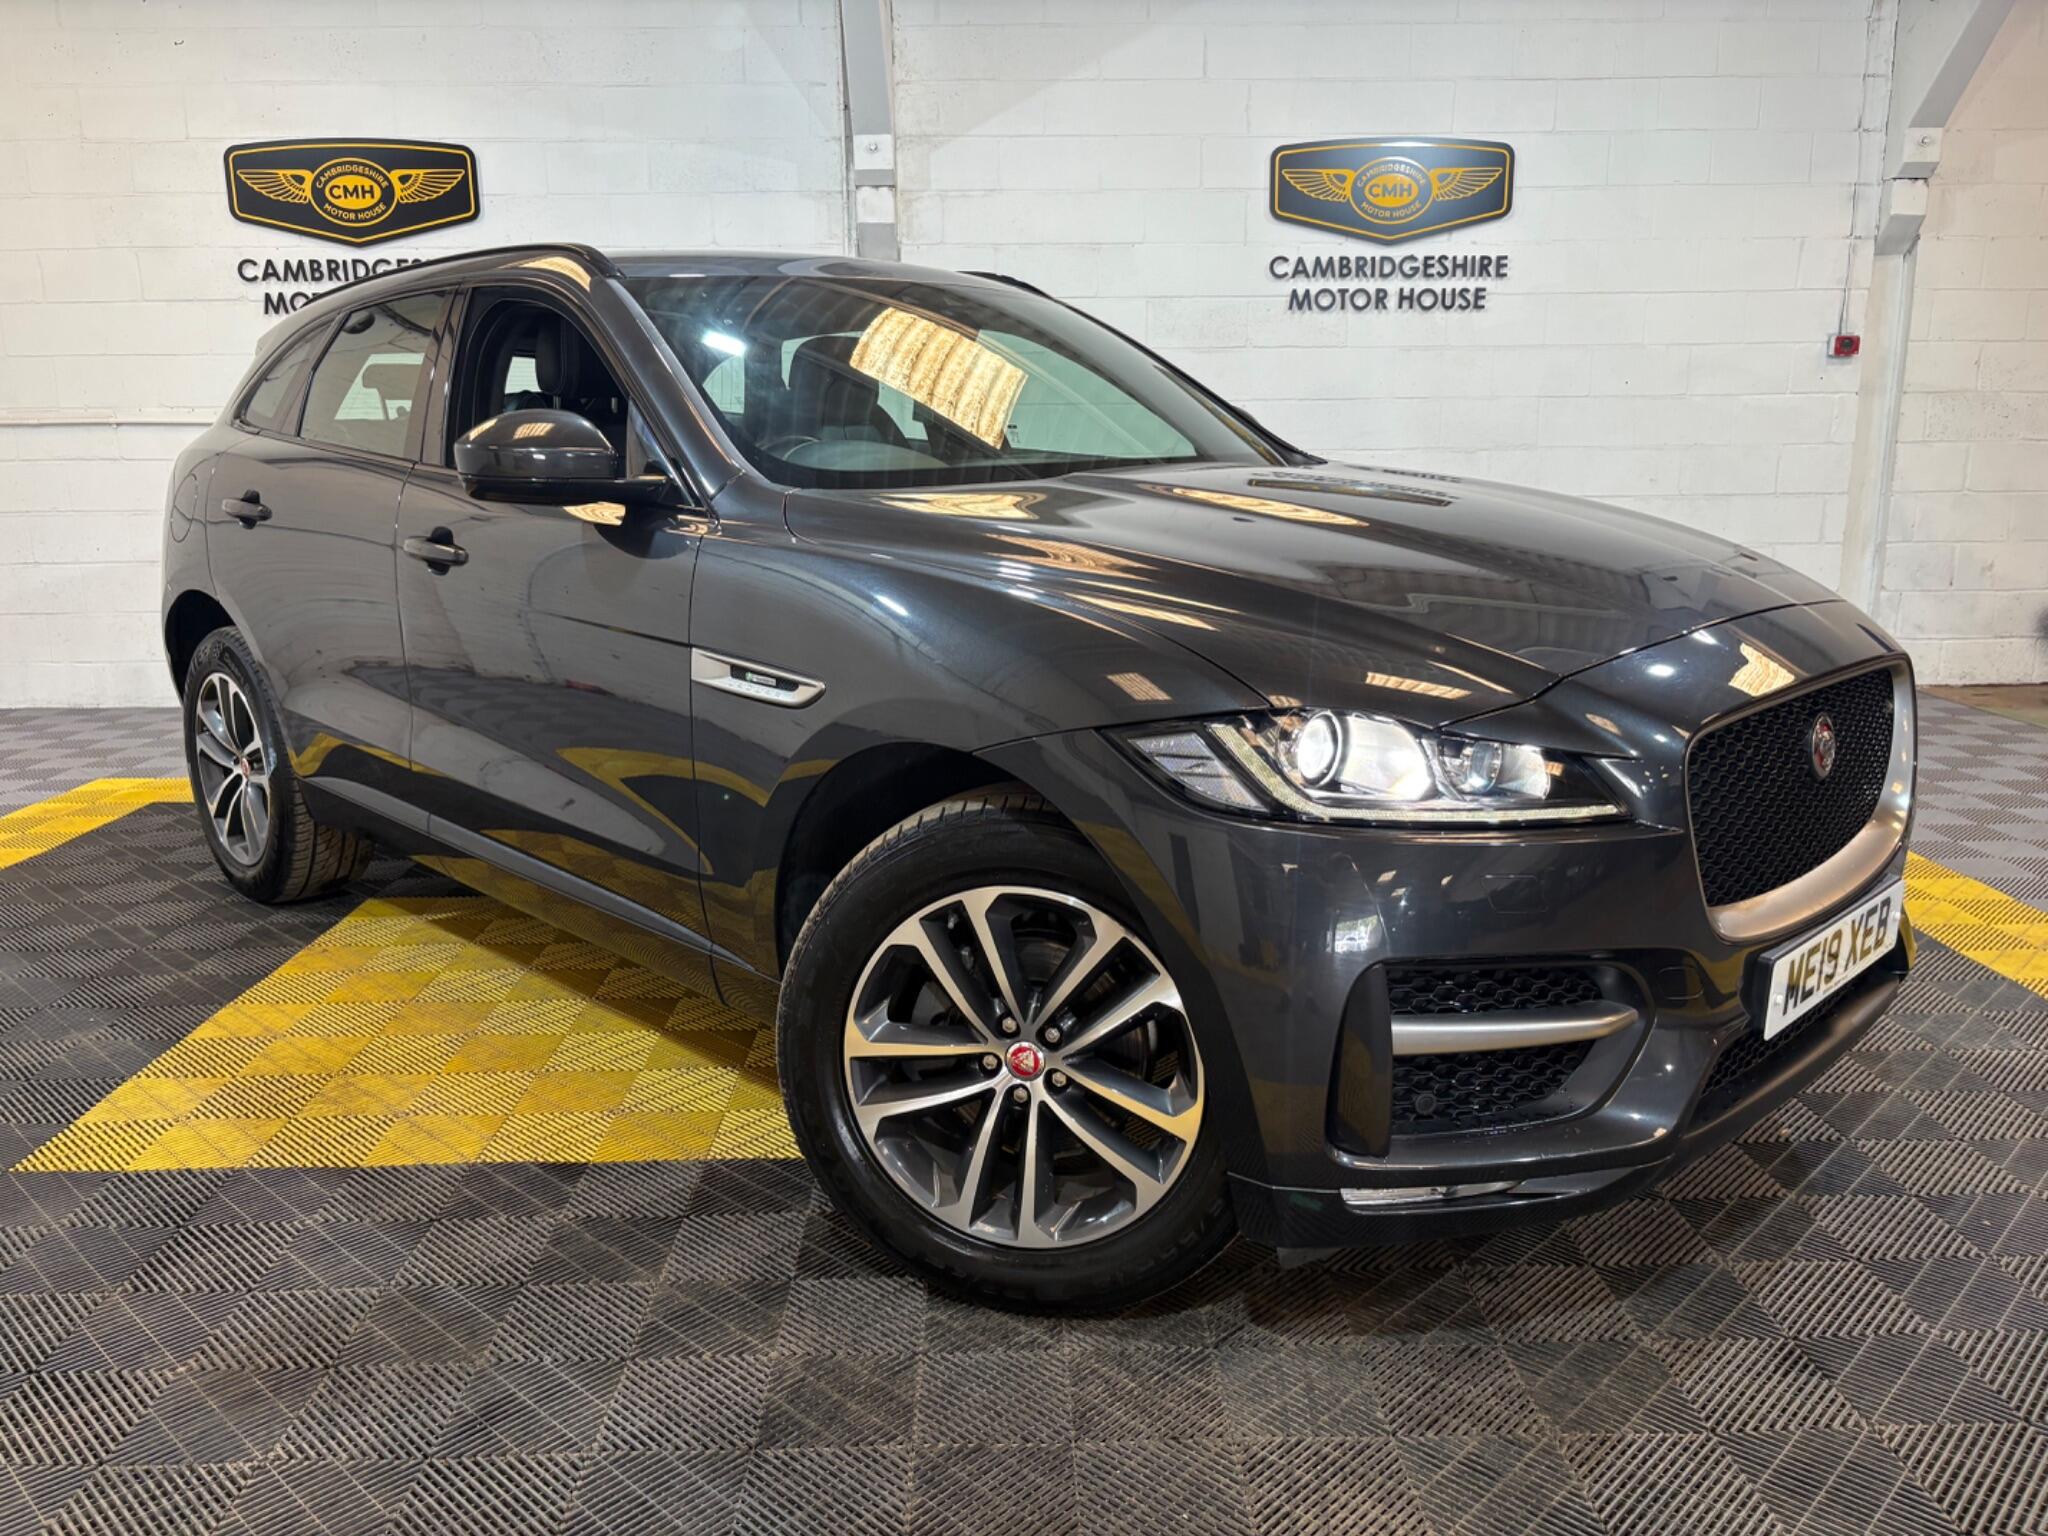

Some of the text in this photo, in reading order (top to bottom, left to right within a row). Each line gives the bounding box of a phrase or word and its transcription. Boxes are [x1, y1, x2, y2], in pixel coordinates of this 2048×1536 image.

[316, 164, 389, 189] CAMBRIDGESHIRE
[1356, 163, 1426, 188] CAMBRIDGESHIRE
[329, 184, 375, 200] CMH
[1368, 183, 1412, 198] CMH
[323, 202, 387, 220] MOTOR HOUSE
[1360, 200, 1422, 217] MOTOR HOUSE
[1269, 255, 1508, 279] CAMBRIDGESHIRE
[1288, 288, 1487, 311] MOTOR HOUSE
[1783, 896, 1891, 1016] ME19 XEB
